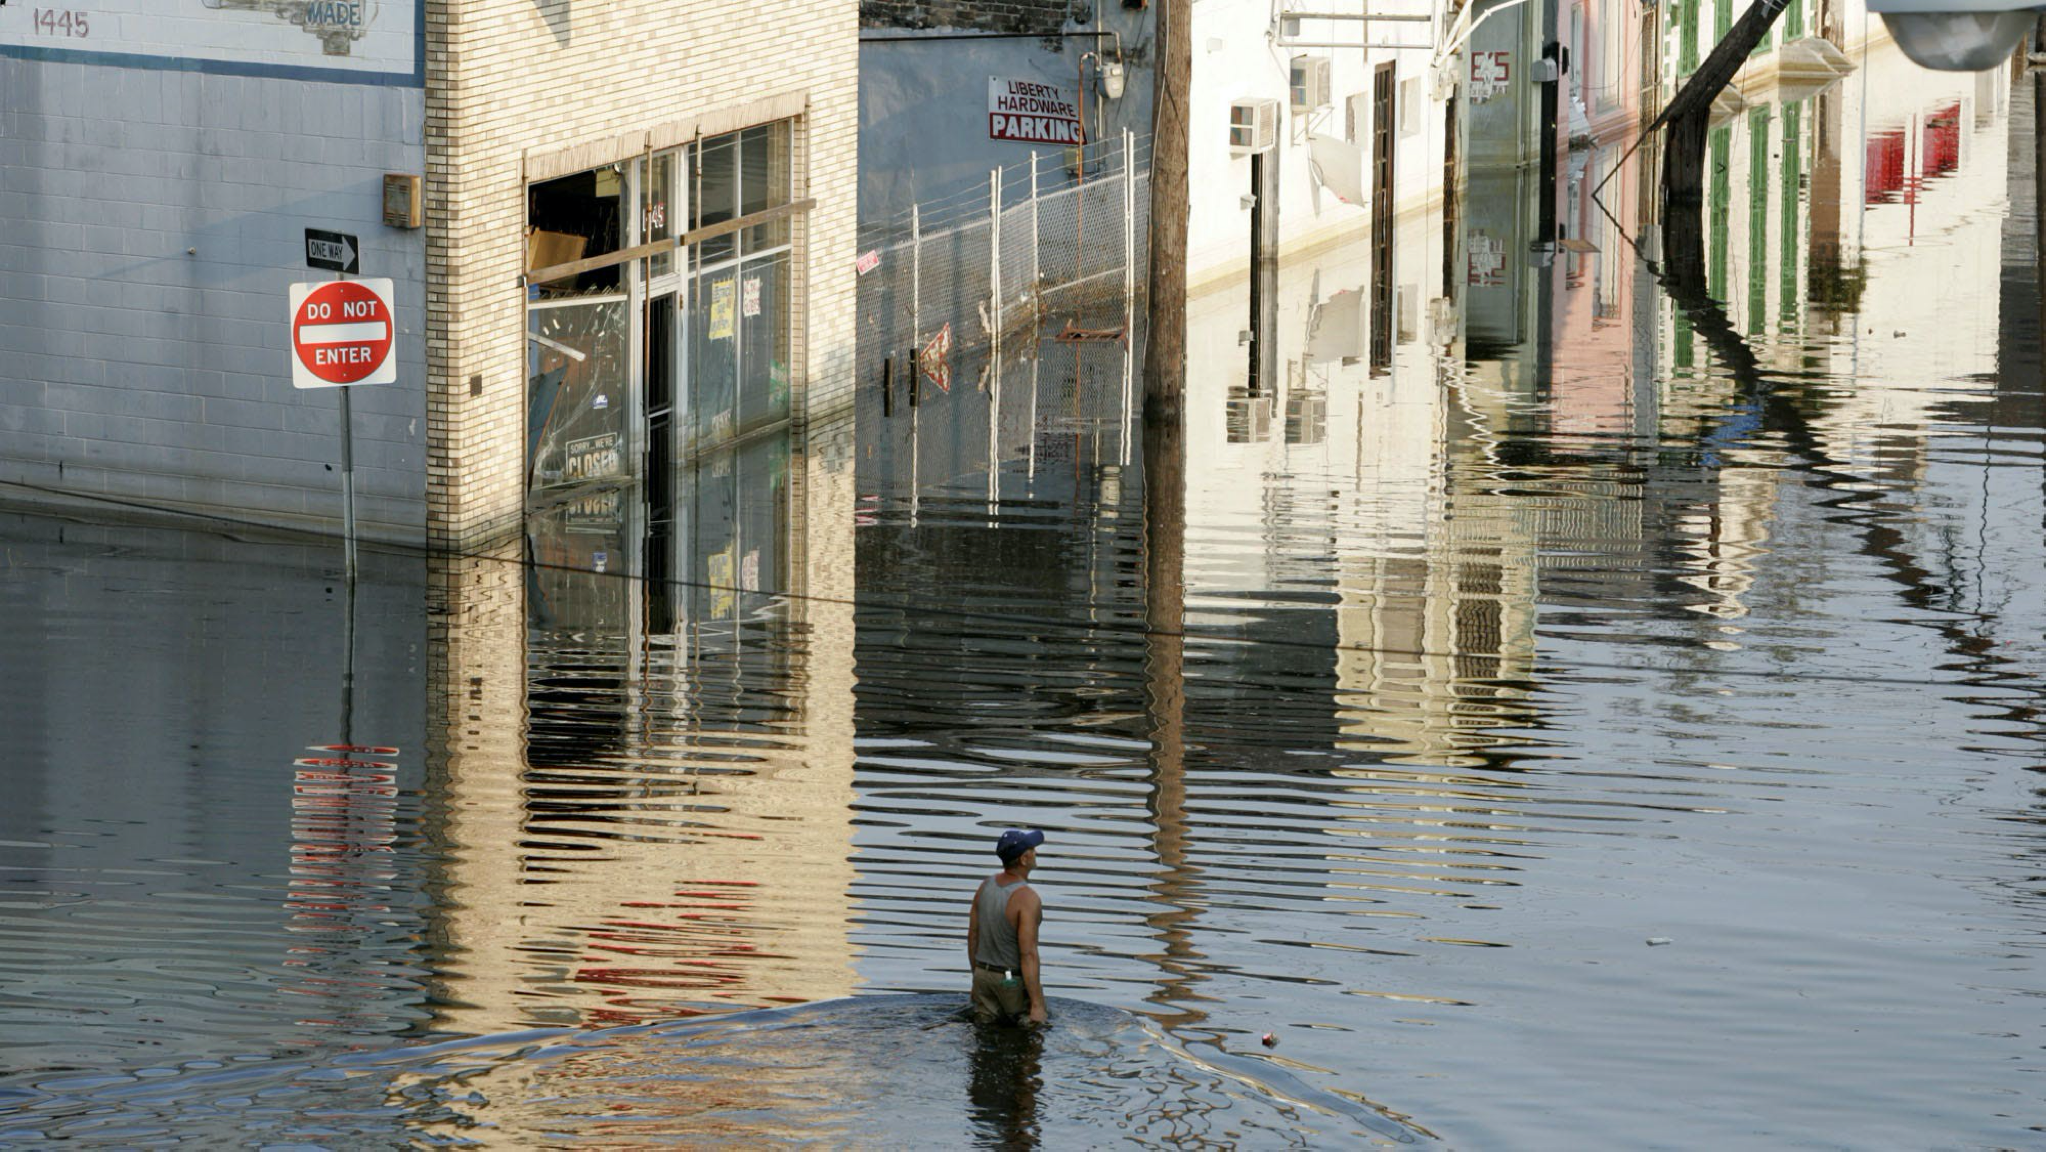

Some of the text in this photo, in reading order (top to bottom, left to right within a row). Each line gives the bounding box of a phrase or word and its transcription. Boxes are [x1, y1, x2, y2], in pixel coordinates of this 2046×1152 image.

[34, 8, 89, 38] 1445
[307, 2, 361, 26] MADE
[1008, 80, 1059, 100] LIBERTY
[998, 95, 1076, 117] HARDWARE
[992, 115, 1084, 142] PARKING
[310, 242, 343, 260] ONE WAY
[307, 301, 378, 320] DO NOT
[315, 346, 372, 365] ENTER
[568, 449, 619, 478] CLOSED
